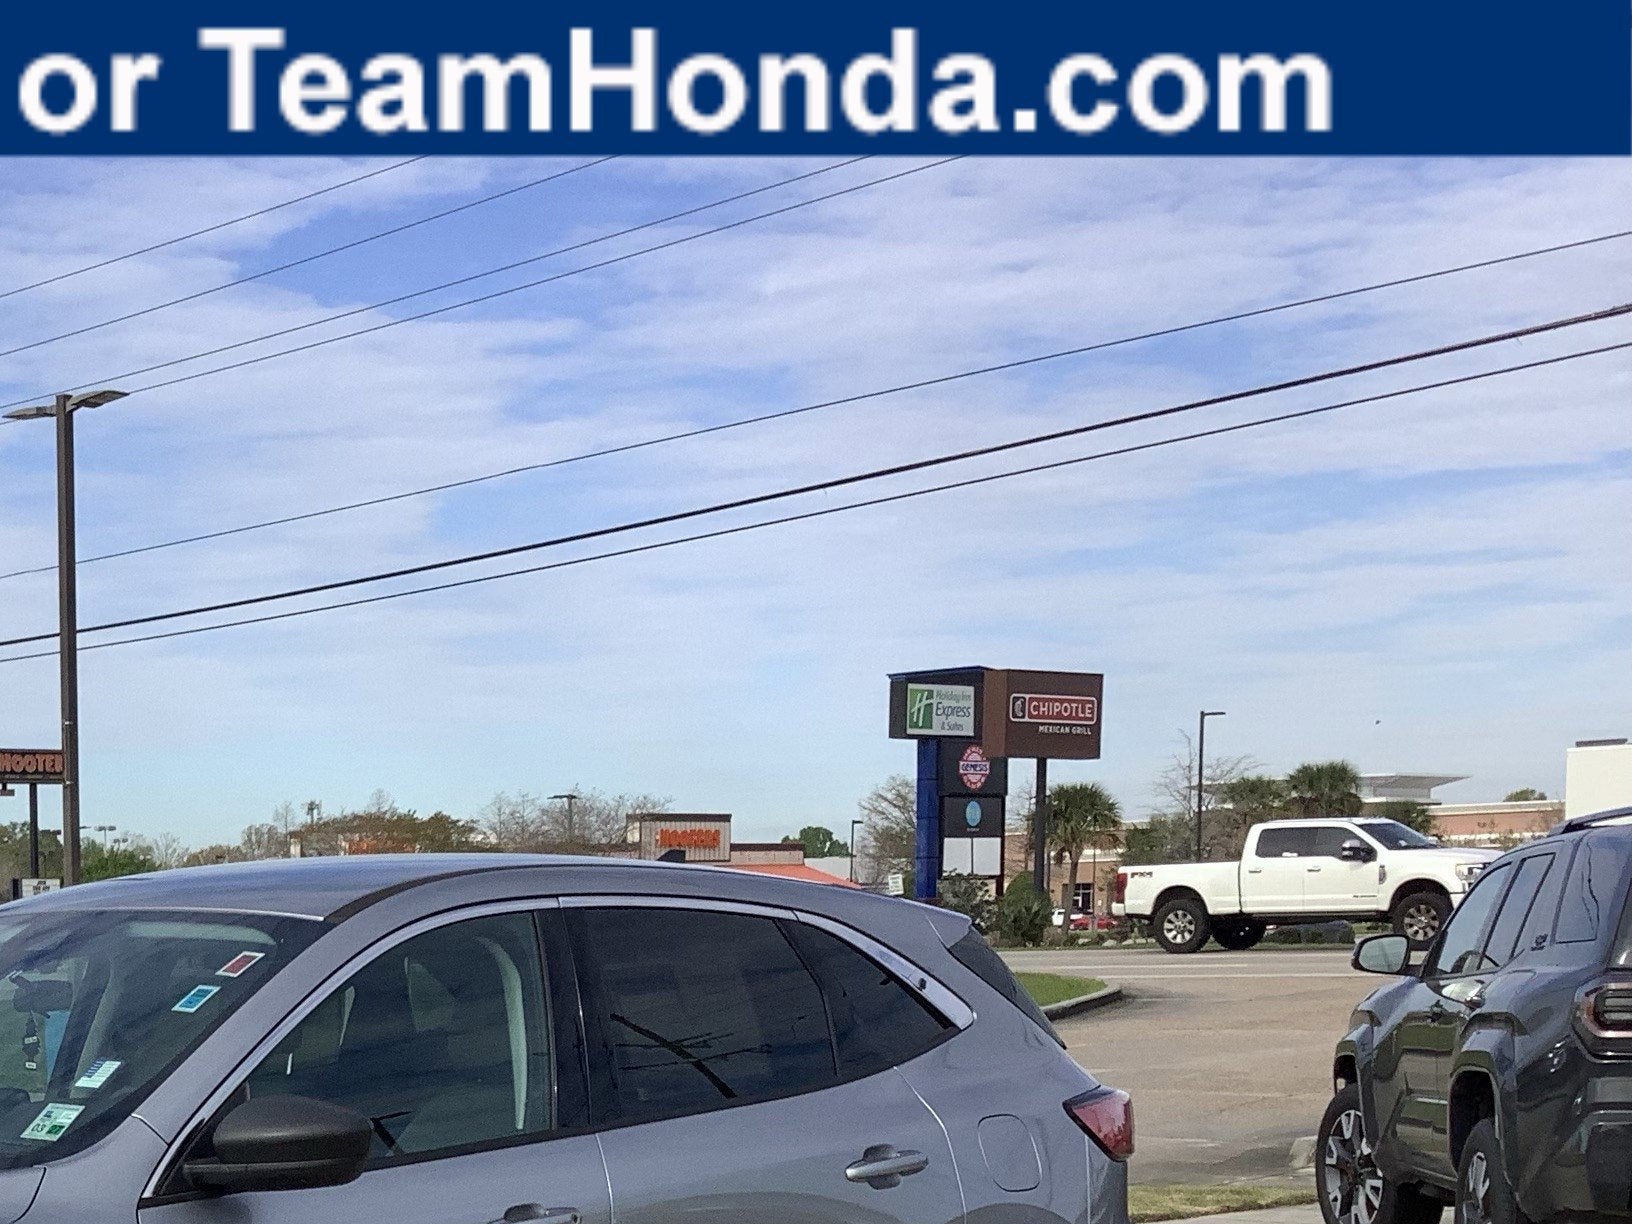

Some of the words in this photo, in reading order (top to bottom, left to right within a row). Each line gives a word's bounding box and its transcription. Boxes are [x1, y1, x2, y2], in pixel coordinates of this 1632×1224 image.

[935, 701, 972, 720] Express
[1030, 701, 1093, 718] CHIPOTLE
[1038, 725, 1070, 734] MEXICAN
[1071, 727, 1092, 735] GRILL
